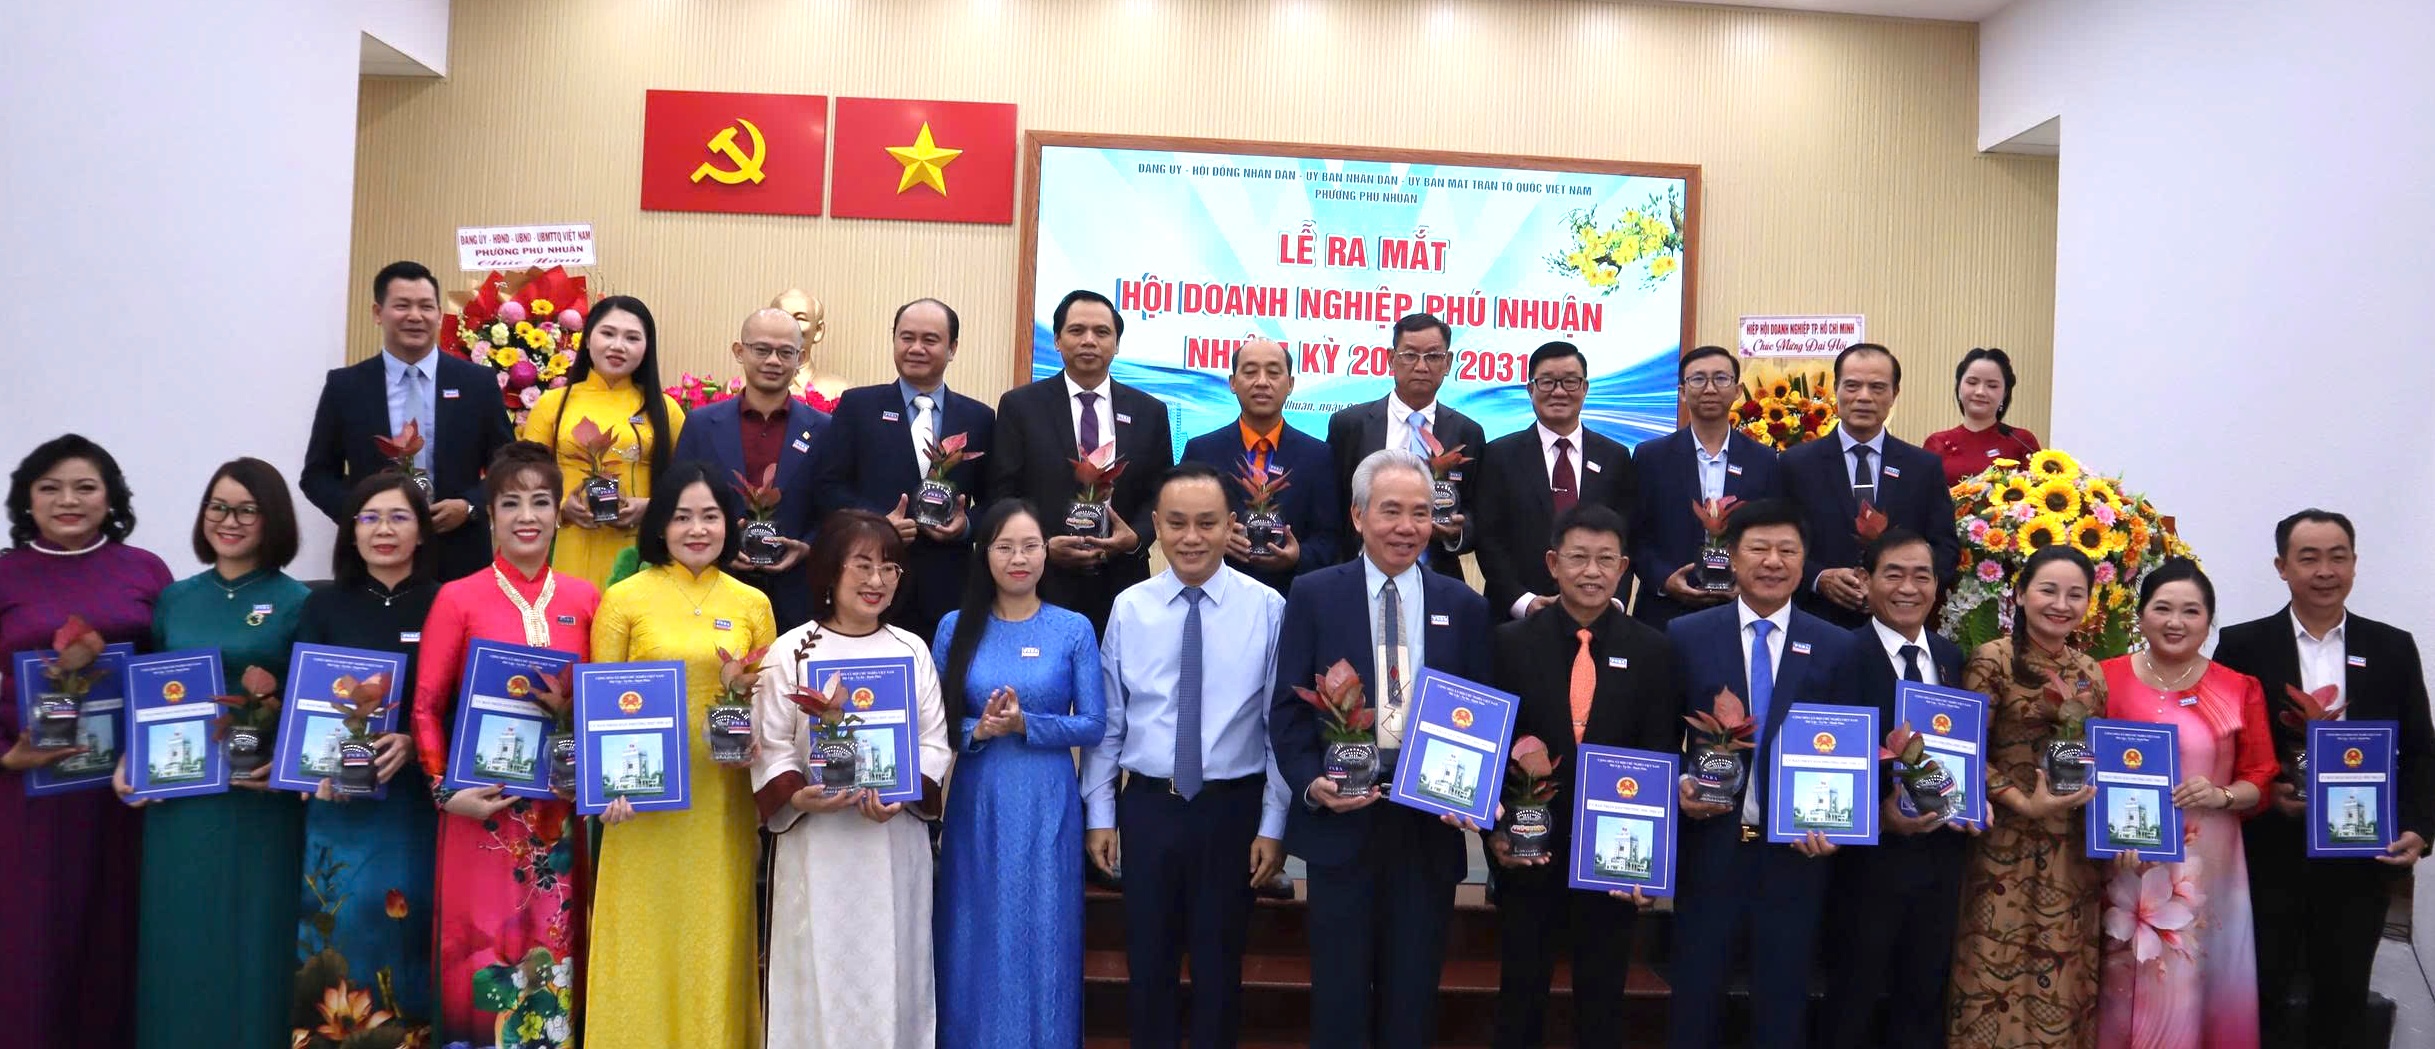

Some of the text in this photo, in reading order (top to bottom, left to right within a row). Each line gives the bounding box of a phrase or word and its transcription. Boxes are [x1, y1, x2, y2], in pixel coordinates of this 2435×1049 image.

[1321, 172, 1343, 183] BAN
[1423, 177, 1445, 188] BAN
[1569, 185, 1592, 196] NAM
[577, 230, 591, 240] NAM
[1280, 222, 1447, 272] LỄ RA MẮT
[1121, 275, 1603, 338] HỘI DOANH NGHIỆP PHÚ NHUẬN
[1770, 323, 1789, 335] DOANH
[1839, 323, 1855, 335] MINH
[1301, 337, 1340, 375] KỲ
[1459, 351, 1528, 383] 2031
